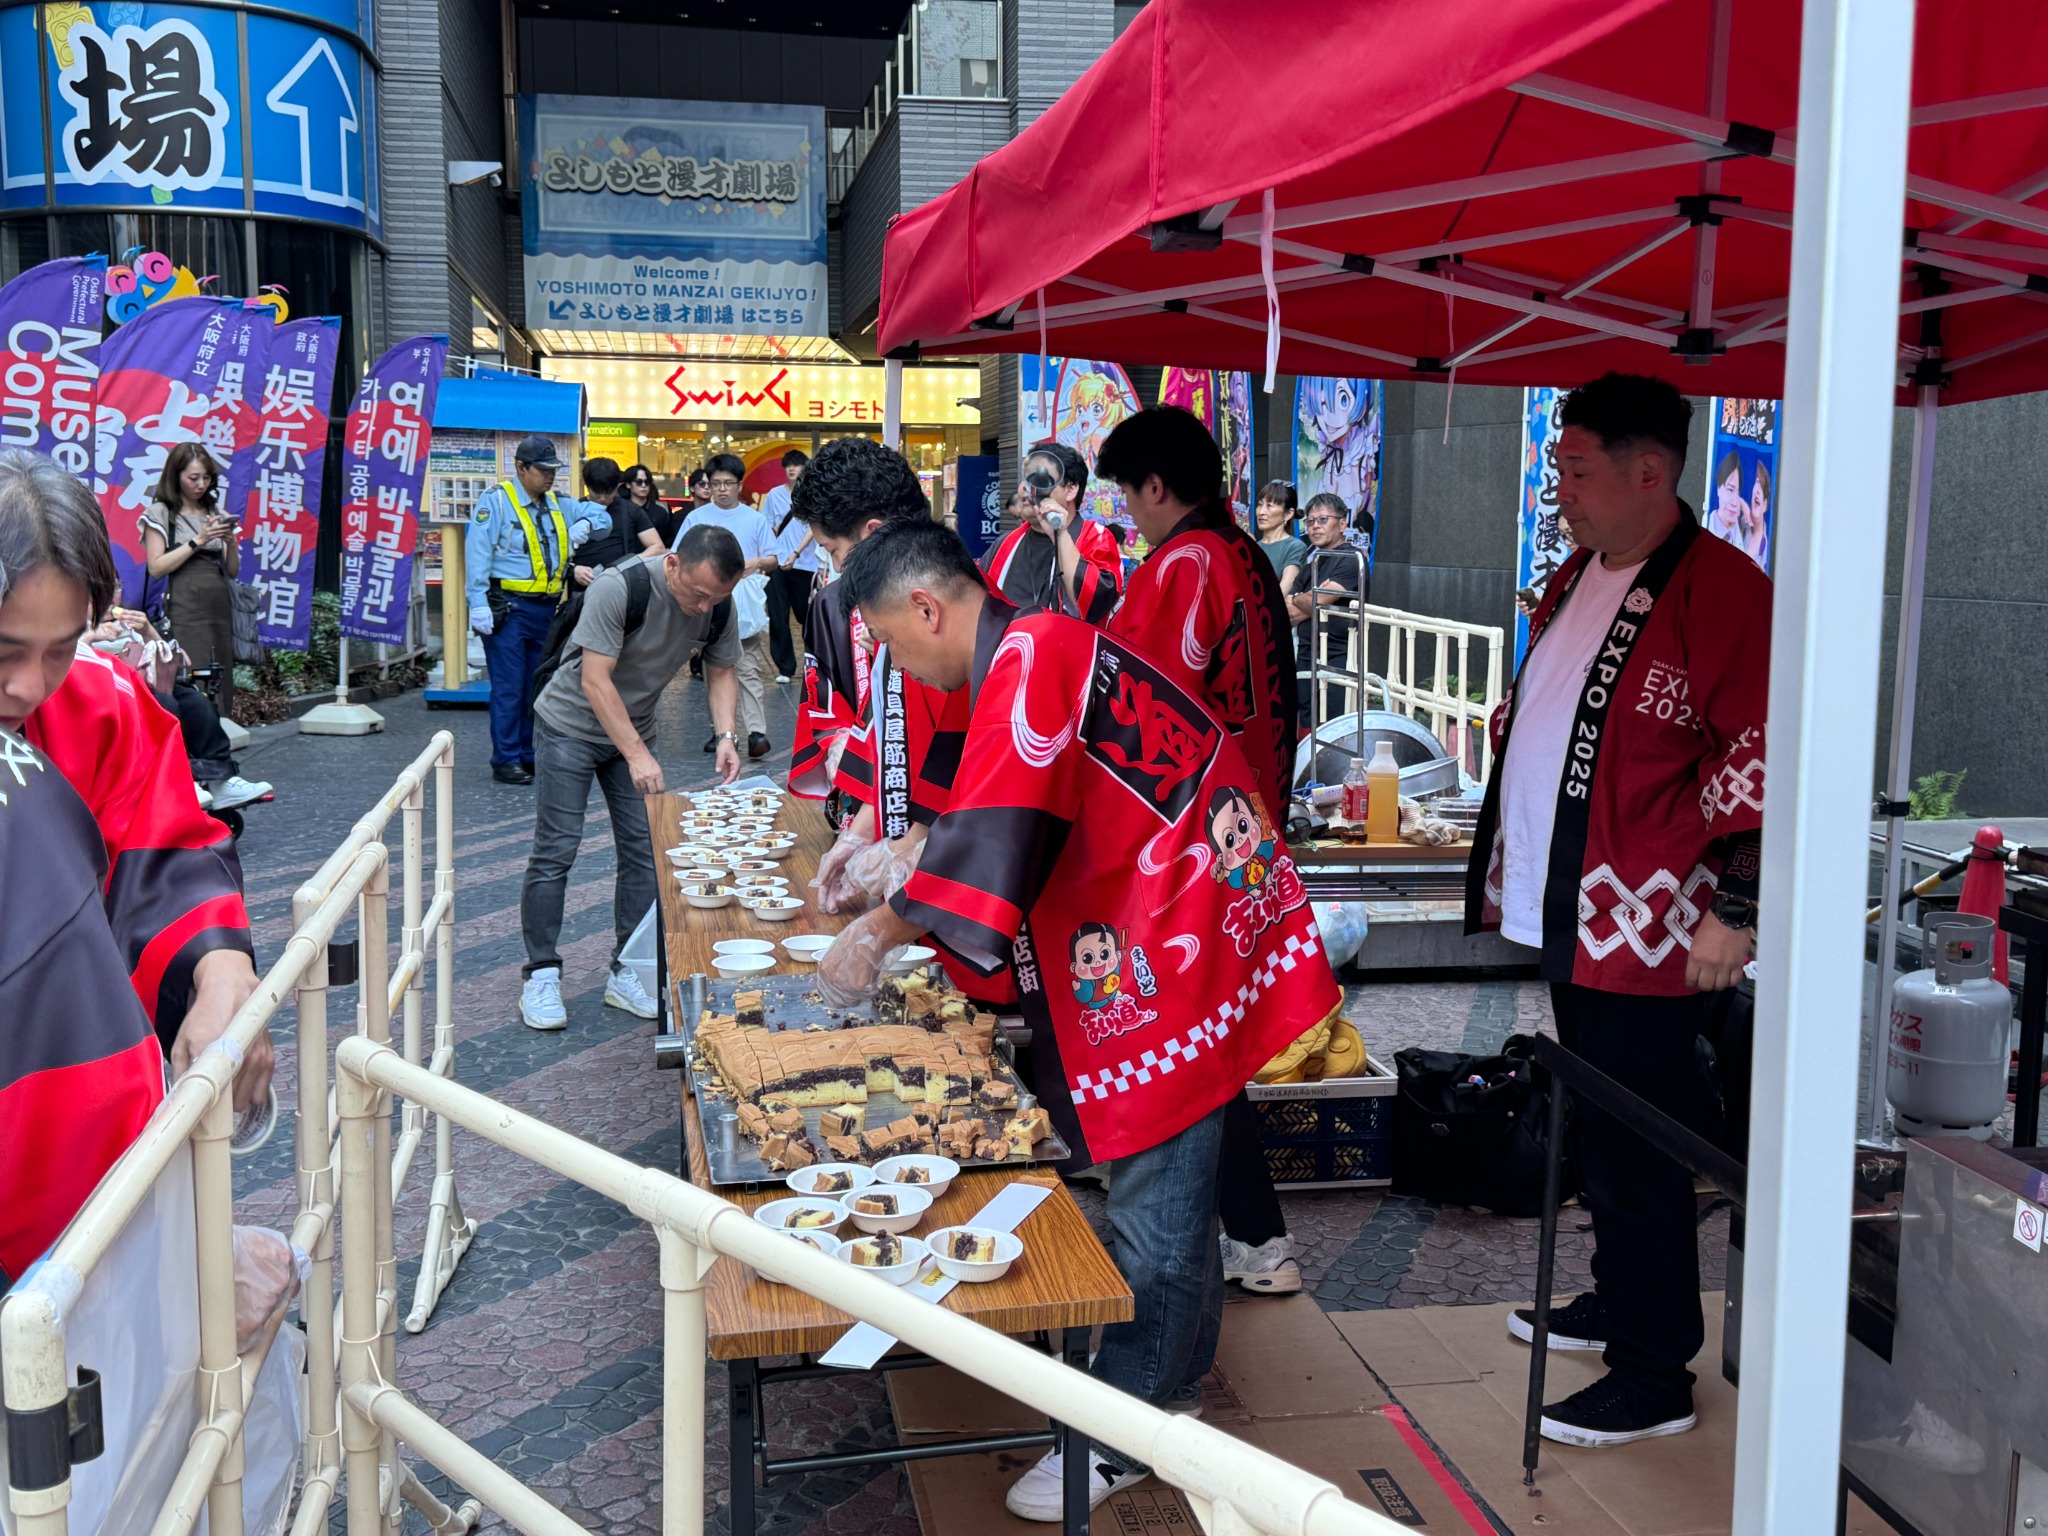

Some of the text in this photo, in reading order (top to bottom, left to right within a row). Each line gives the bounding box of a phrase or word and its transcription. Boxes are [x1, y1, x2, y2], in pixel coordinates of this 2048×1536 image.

[68, 30, 216, 178] 場
[547, 157, 798, 197] よしもと漫才劇場
[537, 280, 817, 302] YOSHIMOTO MANZAI GEKIJYO!
[578, 303, 804, 325] よしもと漫才劇場 はこちら
[192, 312, 227, 377] 大阪府立
[237, 323, 252, 357] 大阪府
[353, 378, 382, 460] 카미가타
[381, 381, 425, 476] 연예
[808, 399, 884, 420] ヨシモト
[250, 364, 316, 629] 娱乐博物馆
[361, 485, 413, 624] 박물관
[1565, 619, 1638, 801] EXPO 2025
[884, 666, 909, 839] 道具屋筋商店街
[1130, 946, 1156, 995] まいど
